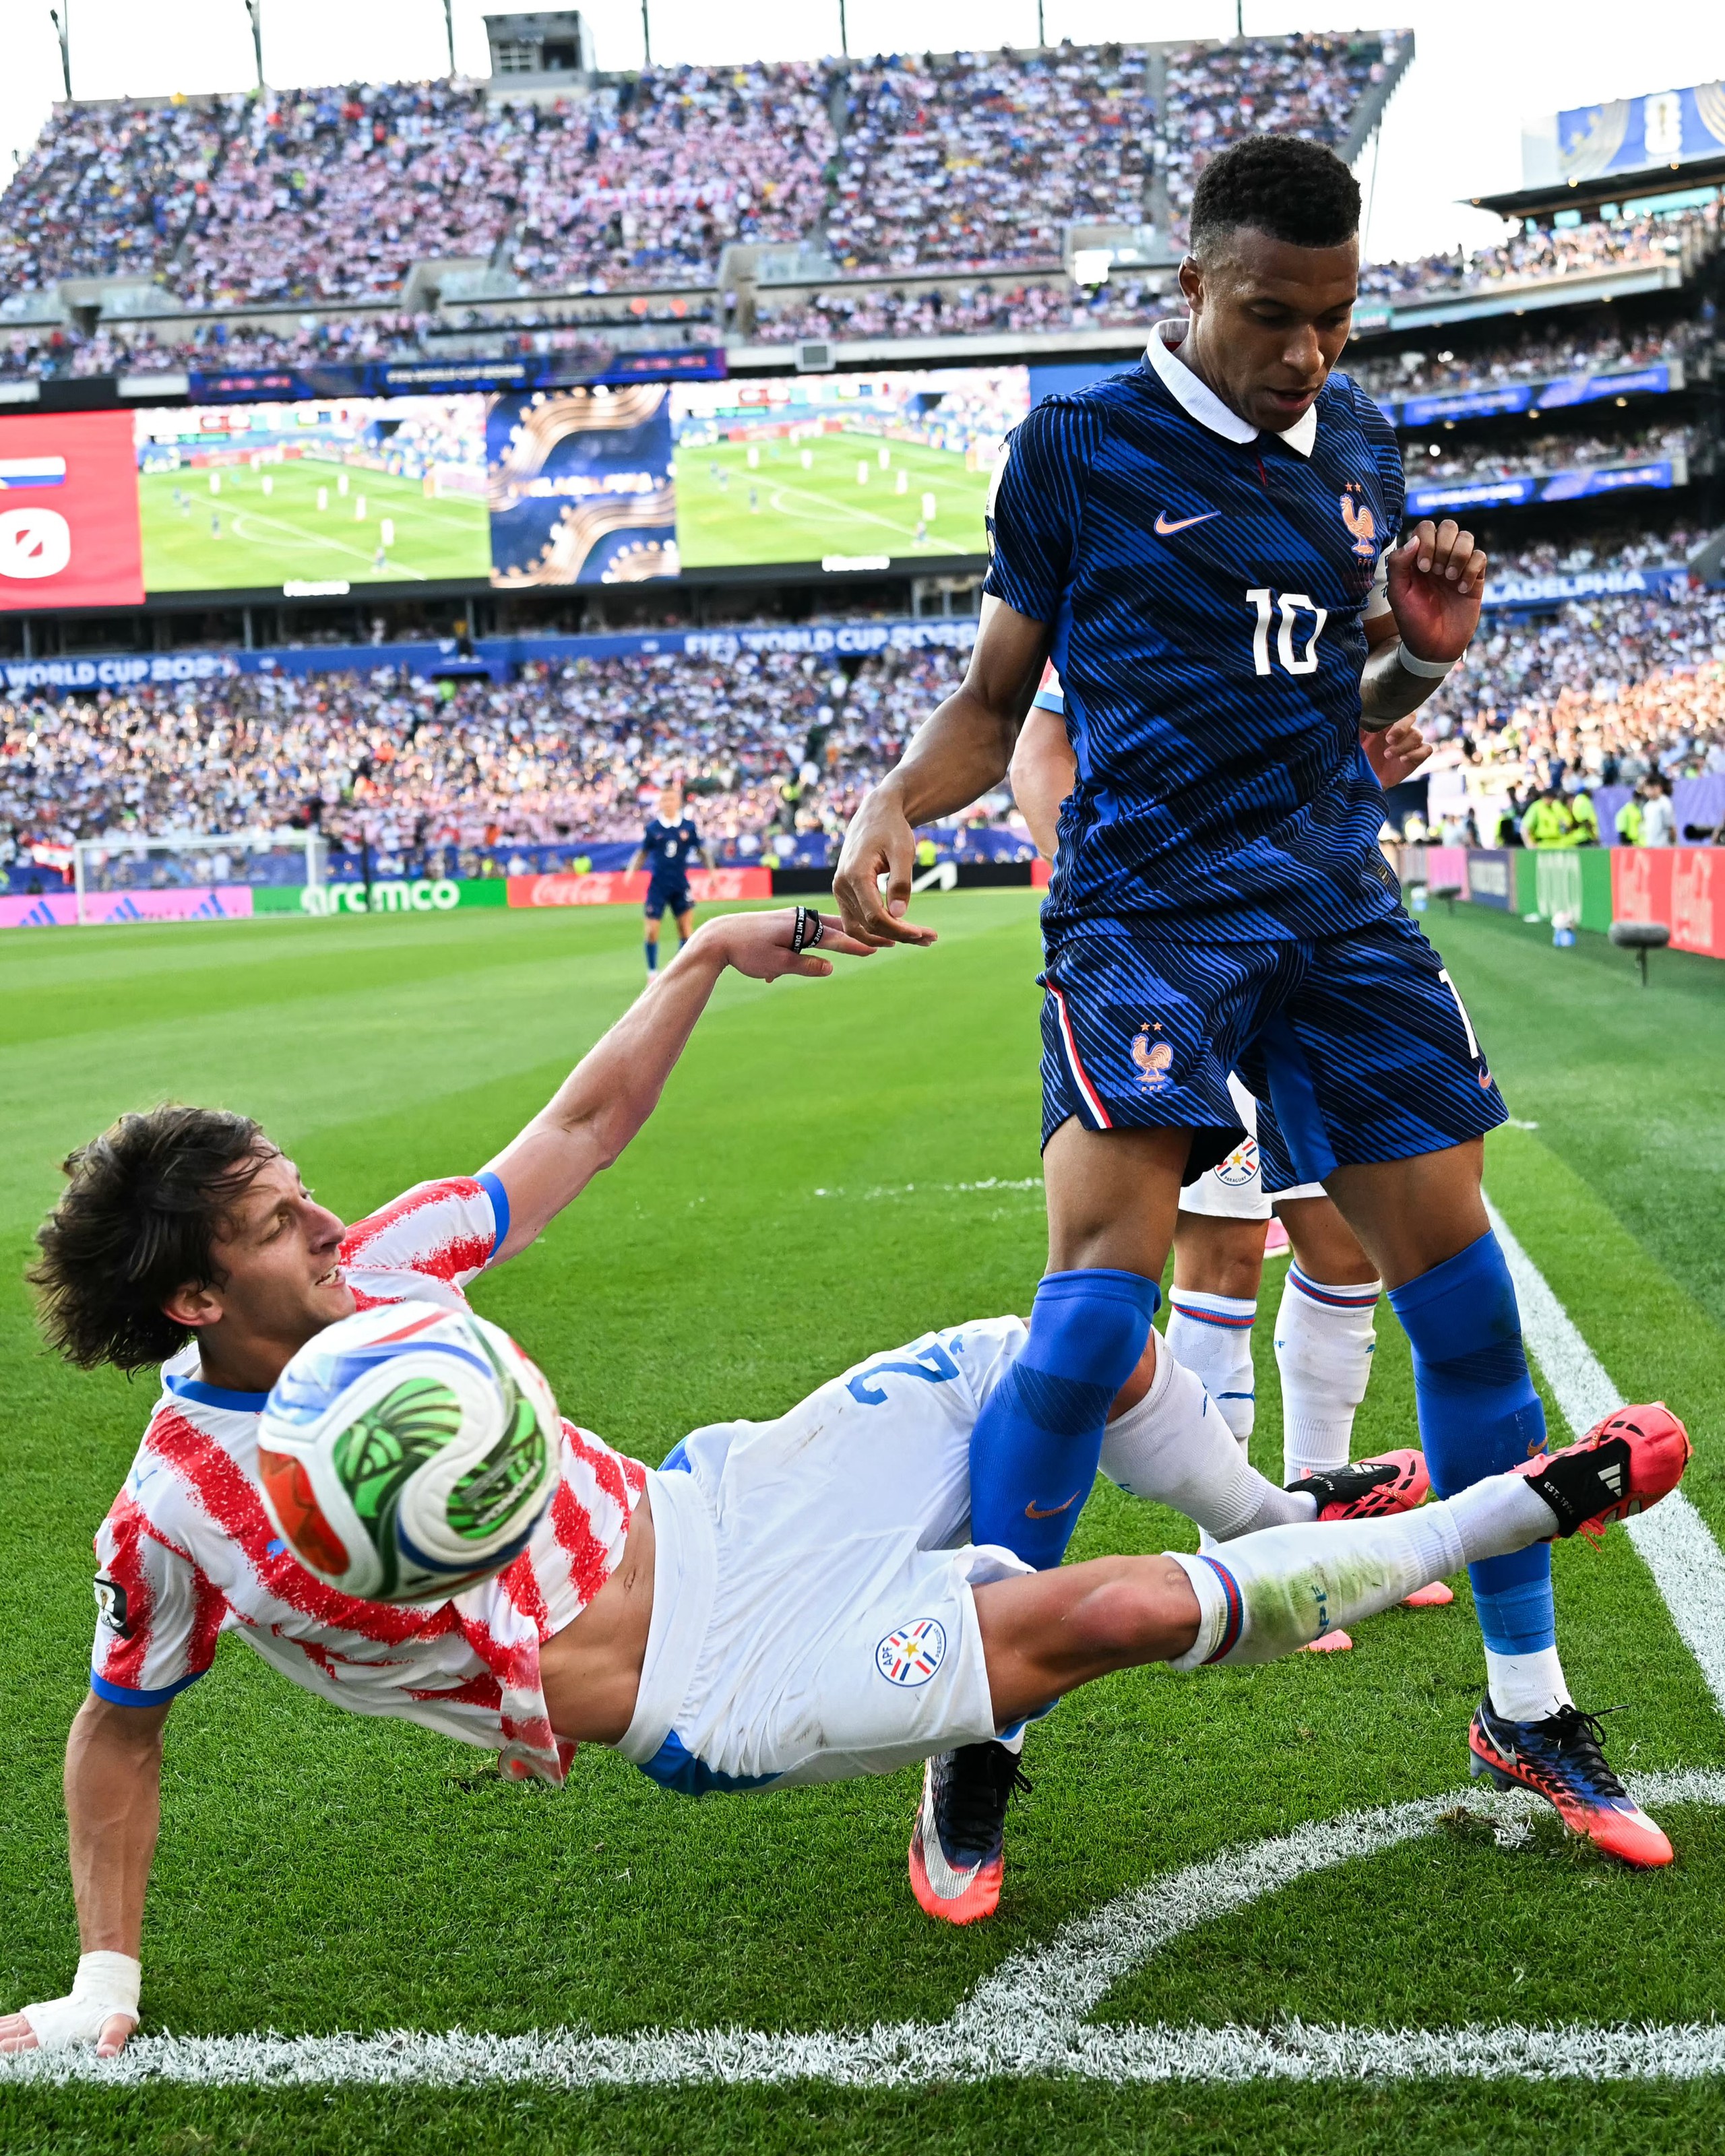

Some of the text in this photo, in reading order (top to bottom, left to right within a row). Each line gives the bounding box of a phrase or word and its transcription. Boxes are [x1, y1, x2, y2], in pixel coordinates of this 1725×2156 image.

[0, 507, 71, 579] 0
[1357, 558, 1373, 567] FFF
[836, 627, 889, 652] CUP
[1246, 588, 1327, 676] 10
[98, 660, 149, 684] CUP
[1438, 968, 1479, 1059] 1
[1544, 1481, 1560, 1499] EST.
[882, 1647, 893, 1666] APF
